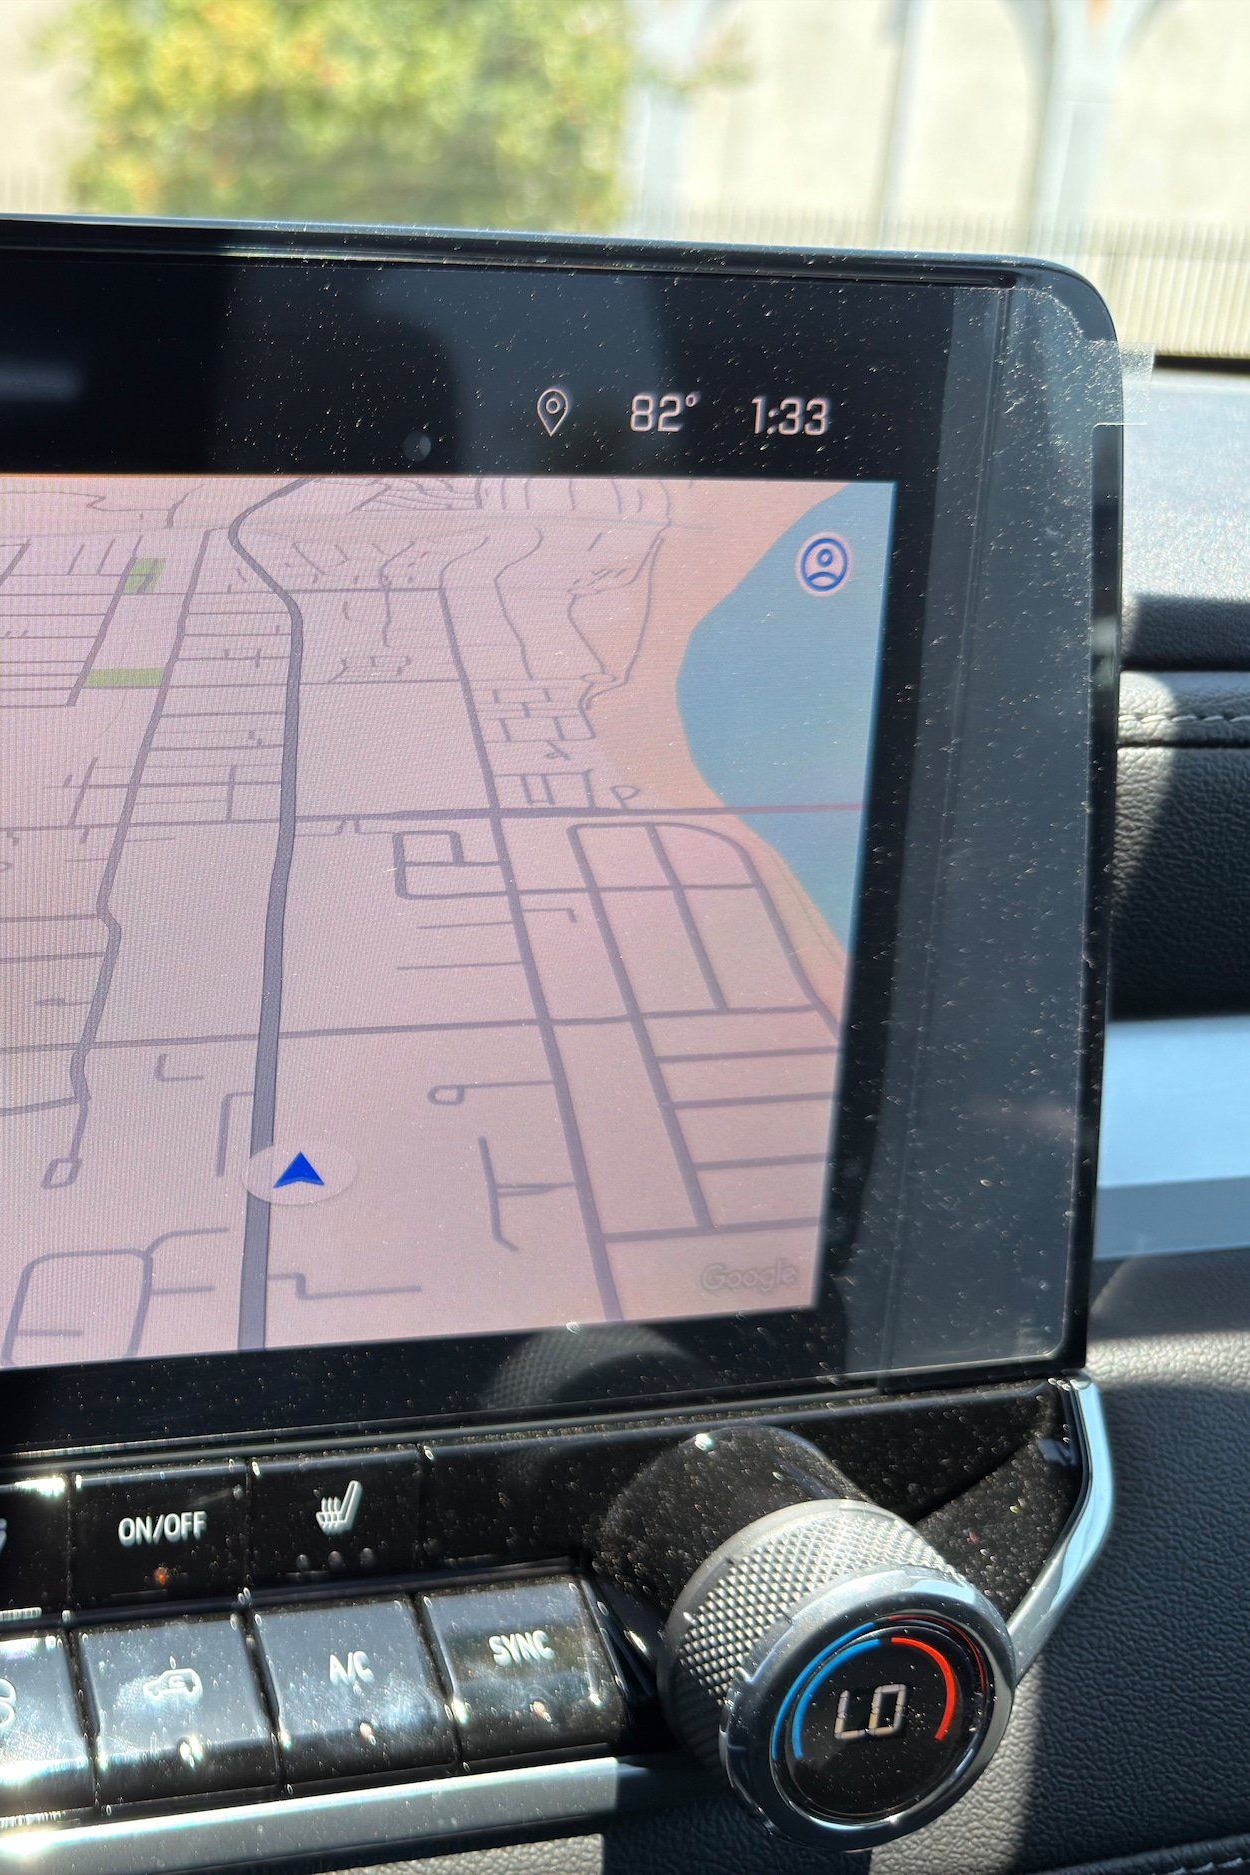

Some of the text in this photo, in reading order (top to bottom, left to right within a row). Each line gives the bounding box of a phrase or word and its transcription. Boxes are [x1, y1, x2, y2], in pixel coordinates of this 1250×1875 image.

[630, 392, 701, 433] 82°
[752, 396, 830, 436] 1:33
[701, 1258, 799, 1294] Google
[118, 1510, 207, 1548] ON/OFF
[487, 1629, 554, 1666] SYNC
[328, 1650, 374, 1686] A/C
